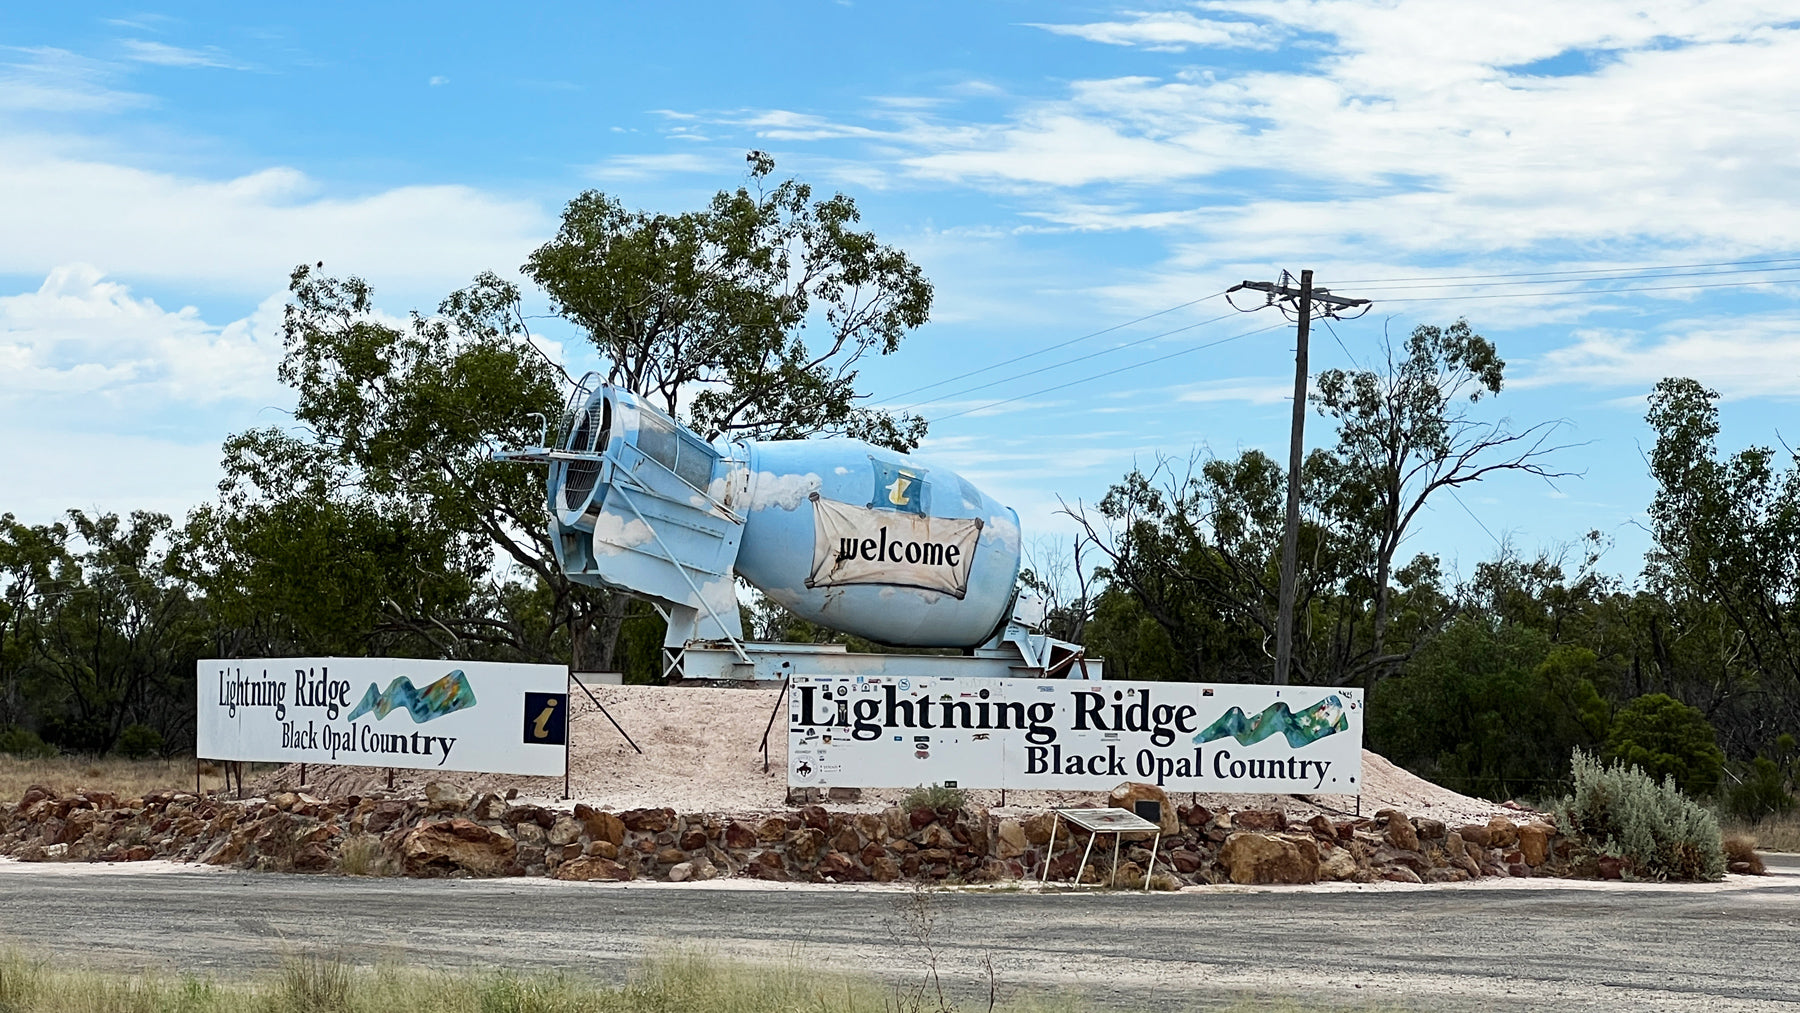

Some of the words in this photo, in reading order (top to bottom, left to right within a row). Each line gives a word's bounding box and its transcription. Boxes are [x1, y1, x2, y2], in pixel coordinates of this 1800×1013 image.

[839, 526, 961, 567] welcome
[219, 667, 287, 721] Lightning
[295, 667, 351, 720] Ridge
[797, 684, 1057, 745] Lightning
[1070, 688, 1198, 747] Ridge
[533, 698, 558, 738] i
[282, 720, 318, 749] Black
[322, 722, 357, 759] Opal
[361, 724, 457, 766] Country
[1024, 744, 1129, 775] Black
[1136, 747, 1204, 786] Opal
